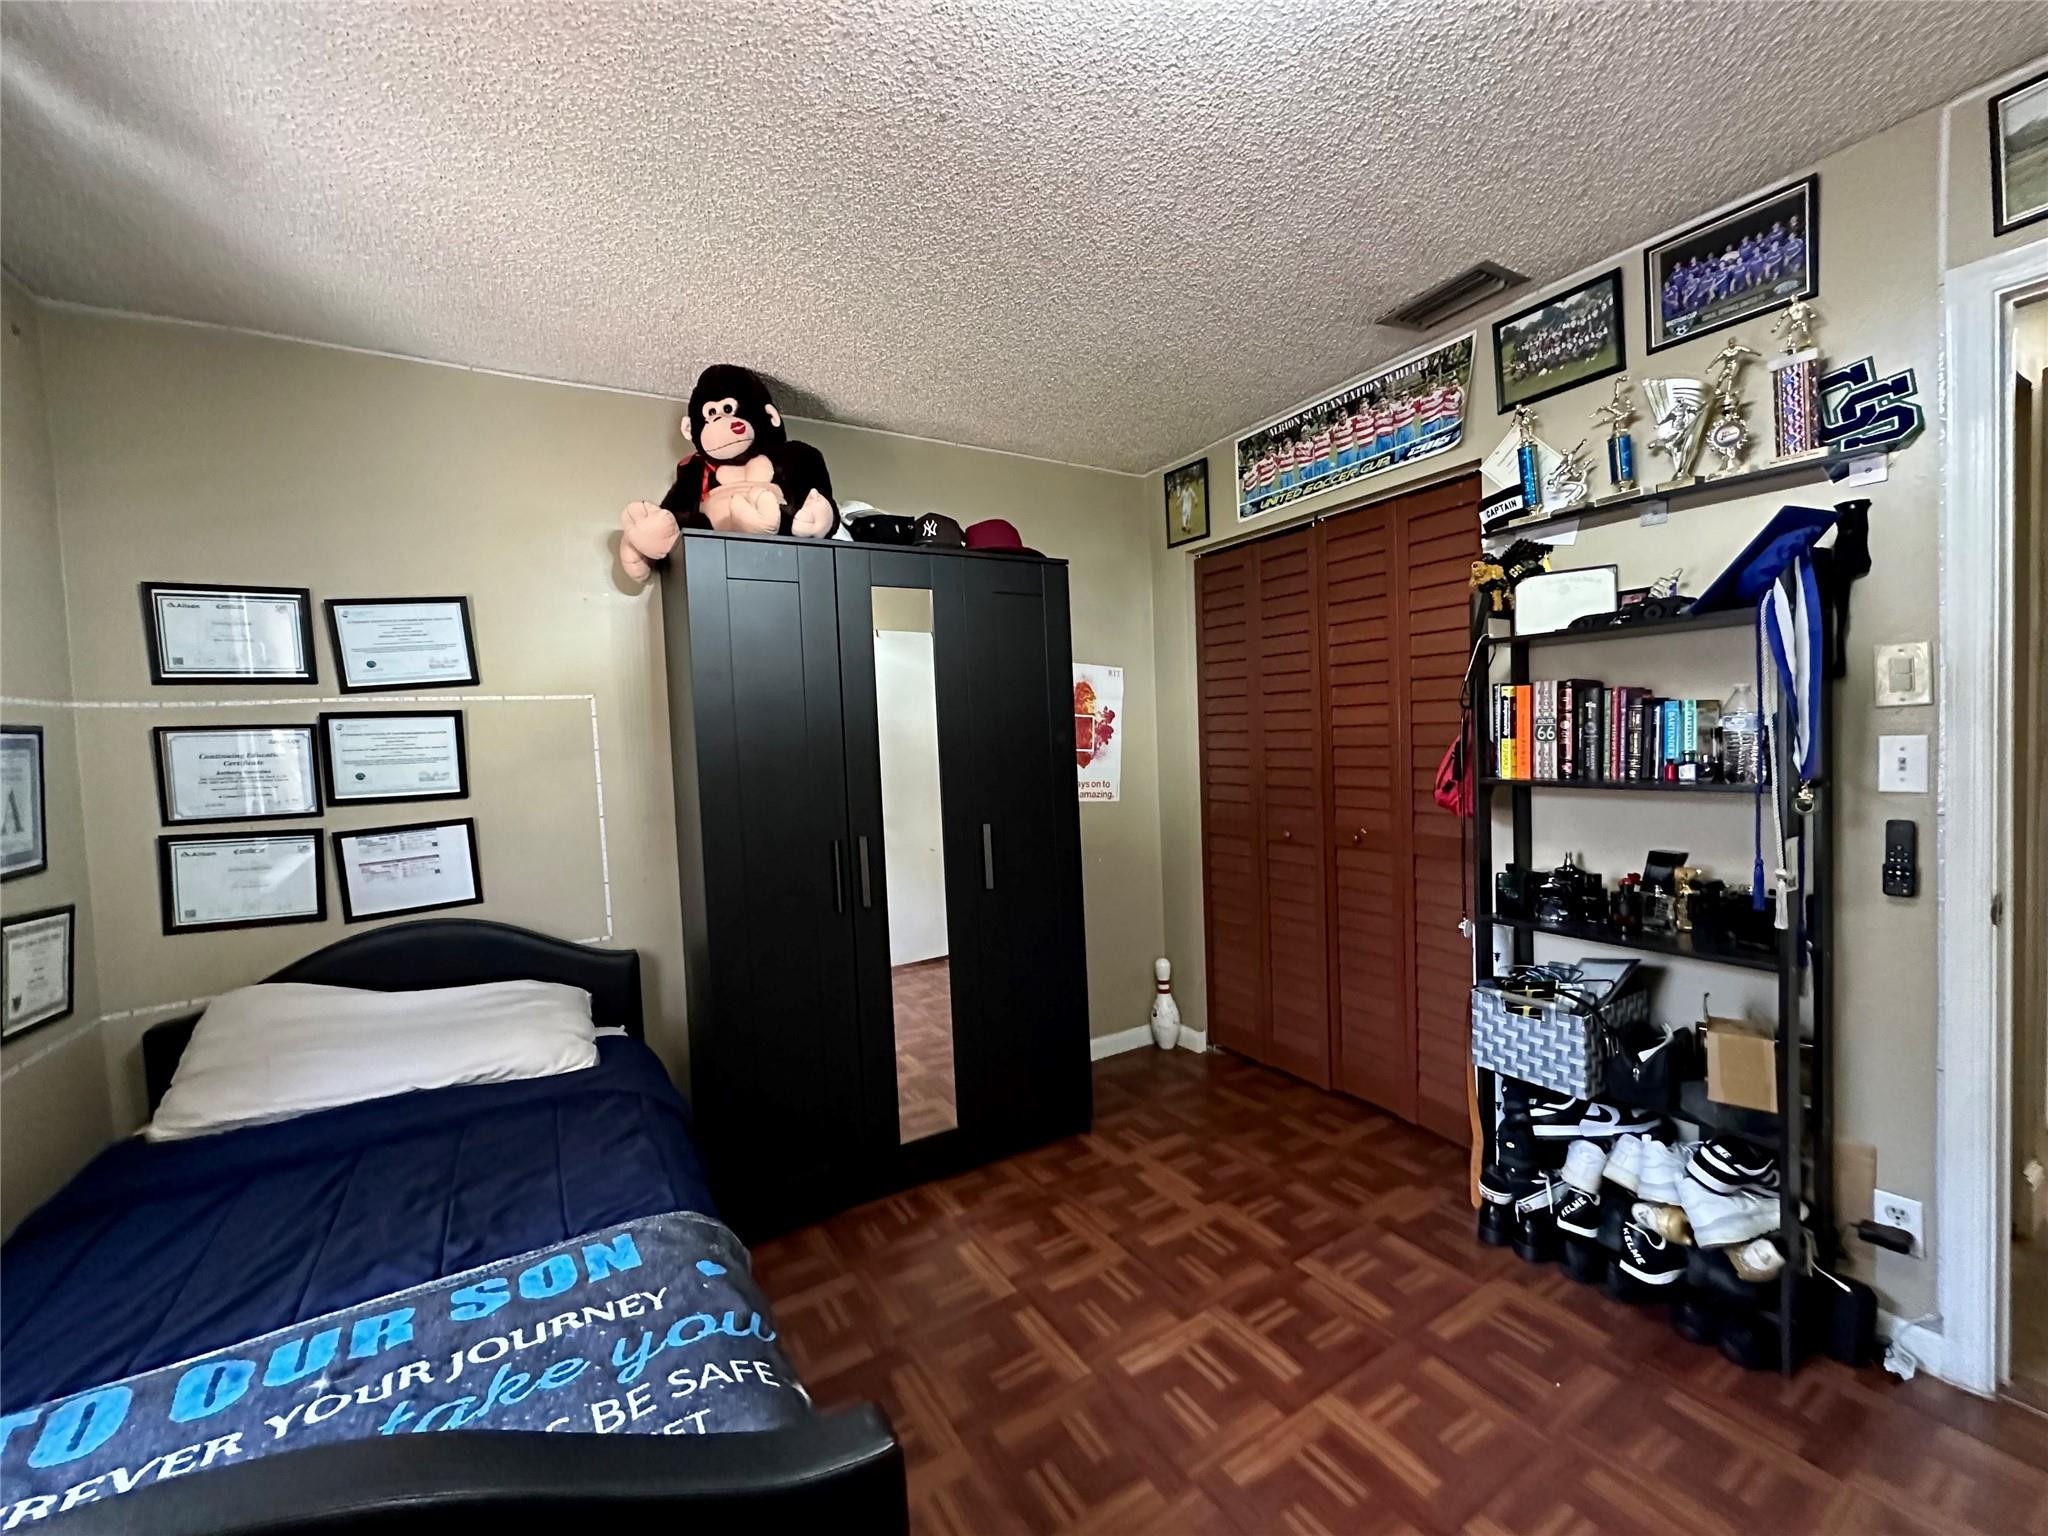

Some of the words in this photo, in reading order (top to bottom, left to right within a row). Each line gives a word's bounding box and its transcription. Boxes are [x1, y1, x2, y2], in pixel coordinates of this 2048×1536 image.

[1268, 417, 1302, 437] ALBION
[1316, 380, 1381, 416] PLANTATION
[1260, 488, 1303, 509] UNITED
[1302, 468, 1358, 496] SOCCER
[1360, 456, 1391, 474] CUP
[1486, 499, 1518, 519] CAPTAIN
[922, 519, 939, 537] NY
[1536, 725, 1556, 741] 66
[1102, 780, 1111, 788] to
[1622, 1227, 1646, 1266] KELME
[168, 1306, 417, 1424] OUR
[449, 1232, 643, 1322] SON
[377, 1357, 591, 1436] take
[611, 1311, 777, 1384] you
[590, 1382, 657, 1435] BE
[667, 1359, 782, 1399] SAFE
[0, 1431, 243, 1531] REVER
[264, 1359, 435, 1440] YOUR
[445, 1286, 668, 1384] JOURNEY
